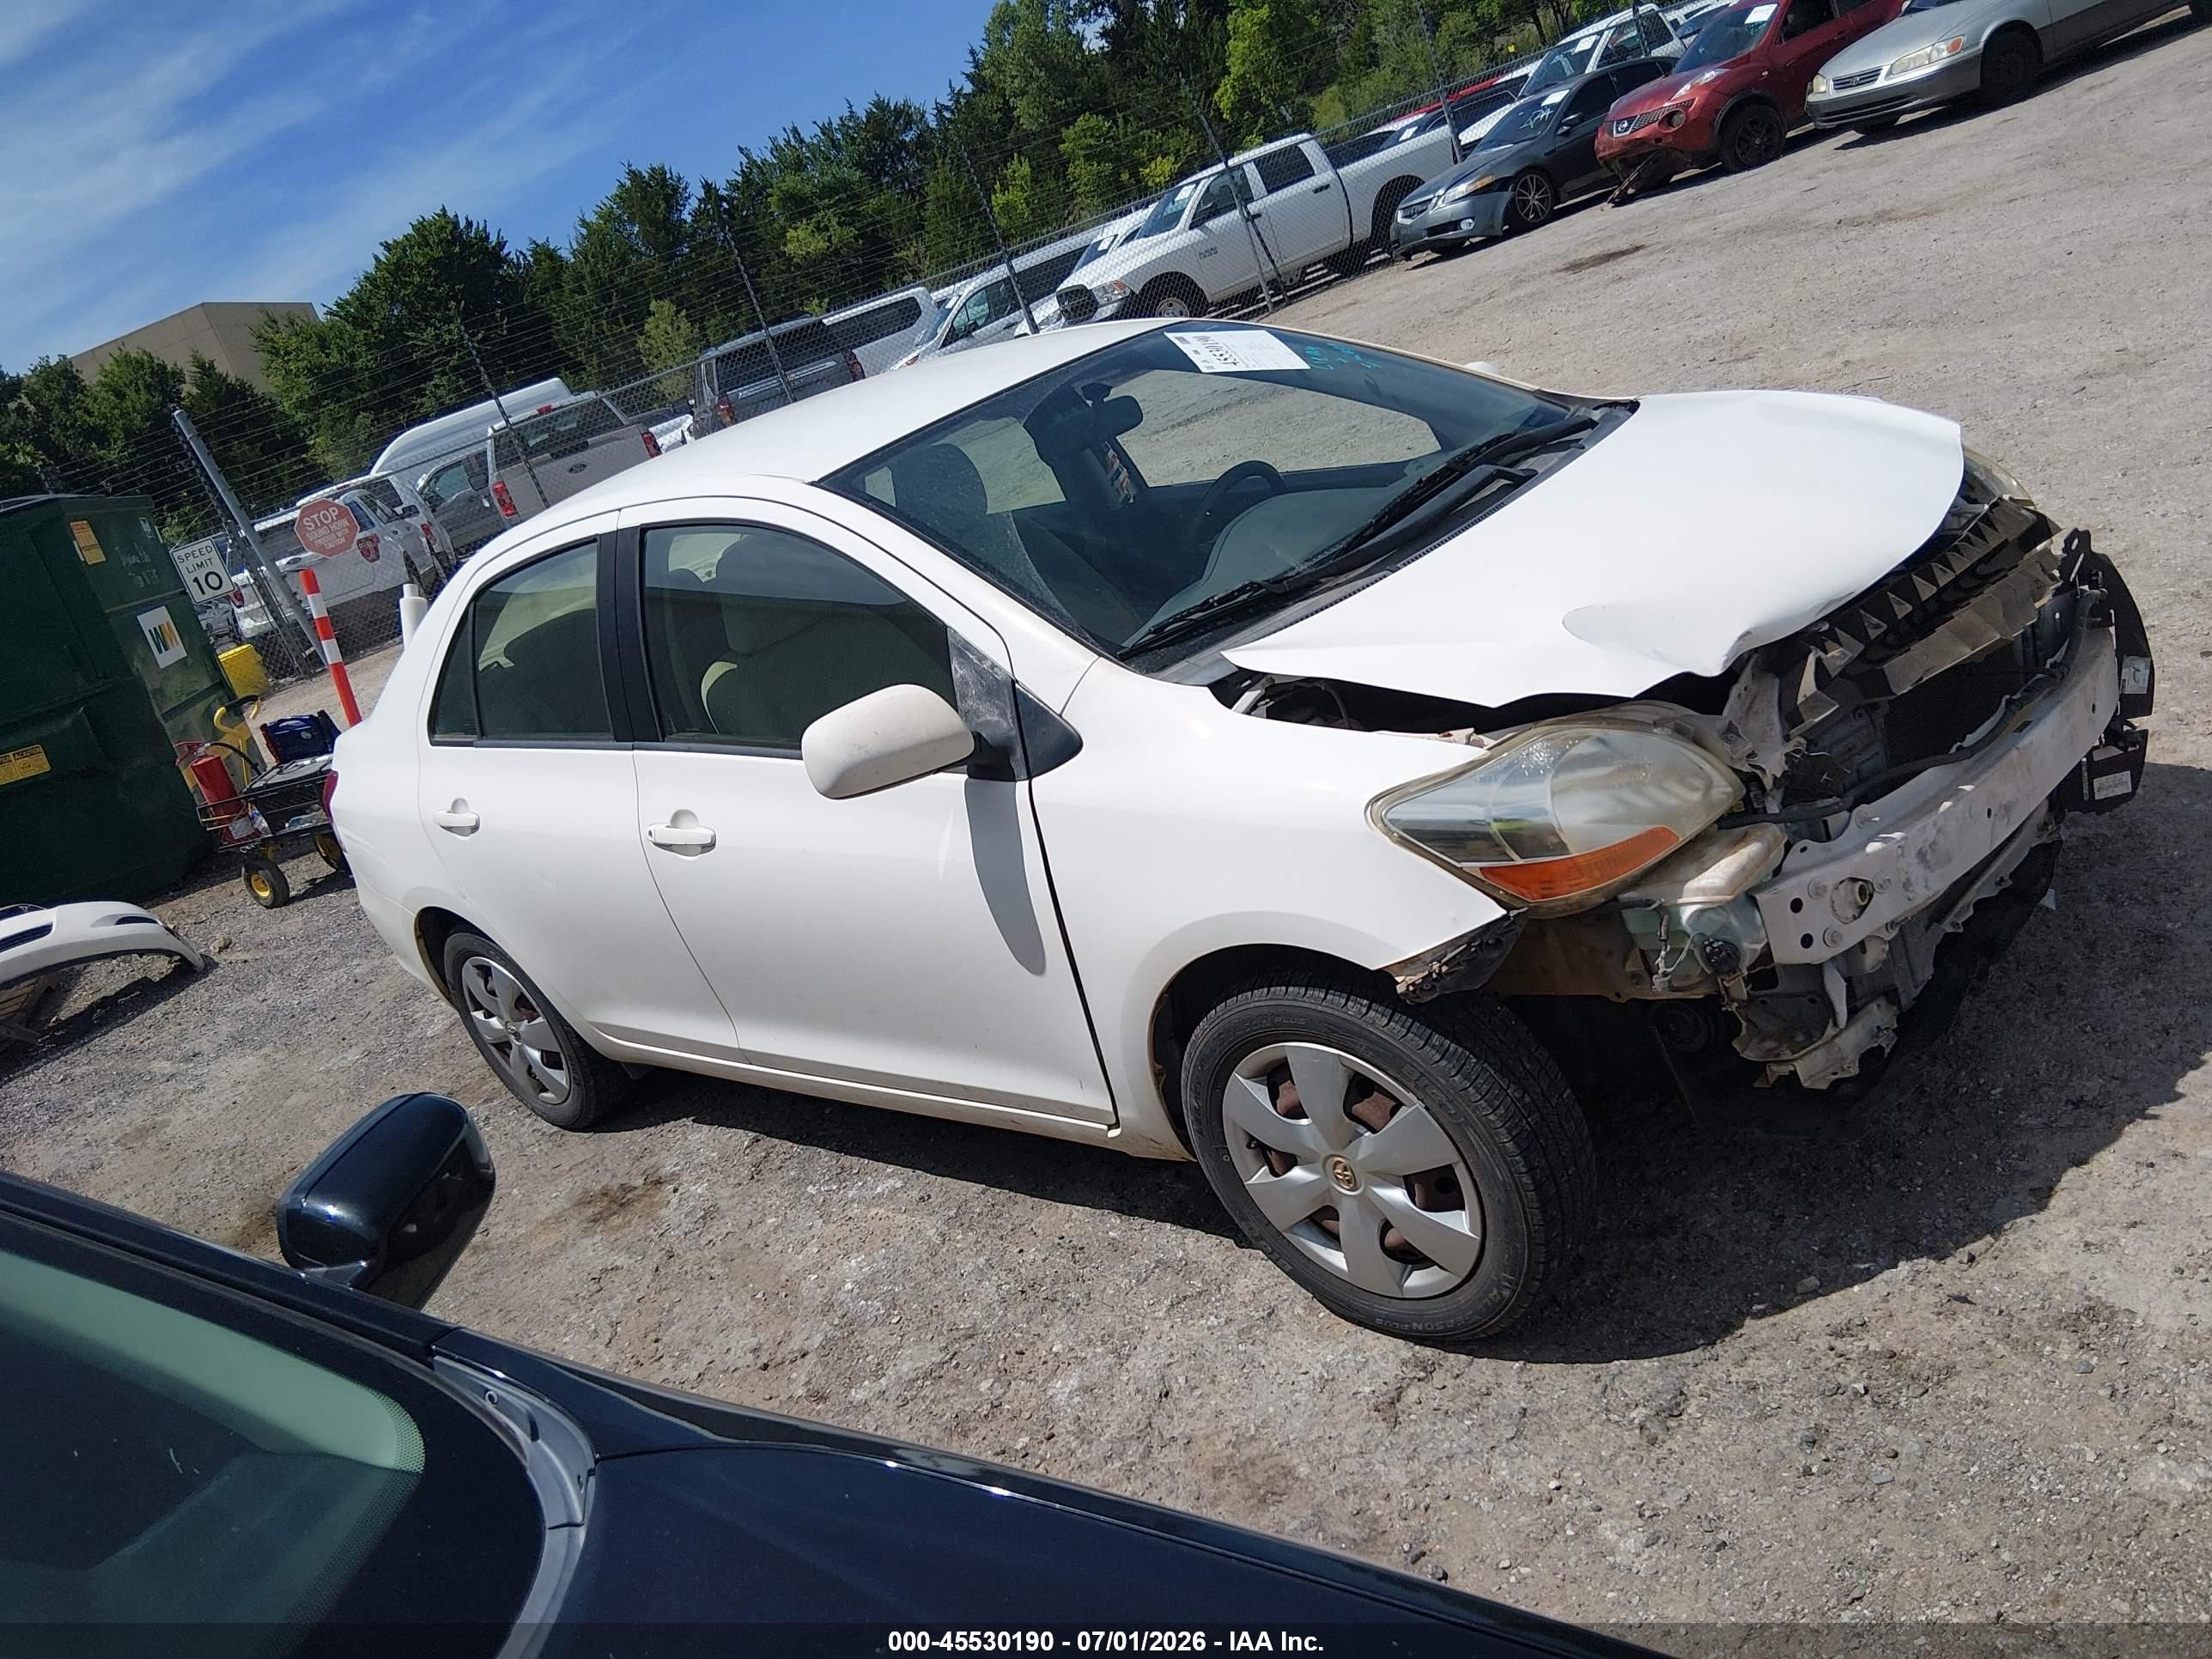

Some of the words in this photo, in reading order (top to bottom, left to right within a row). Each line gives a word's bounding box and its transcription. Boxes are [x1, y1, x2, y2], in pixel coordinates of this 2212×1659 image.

[303, 507, 339, 531] STOP
[307, 526, 330, 541] SOUND
[329, 518, 349, 532] HORN
[177, 545, 213, 563] SPEED
[185, 557, 214, 574] LIMIT
[192, 571, 223, 595] 10
[148, 621, 179, 654] WM
